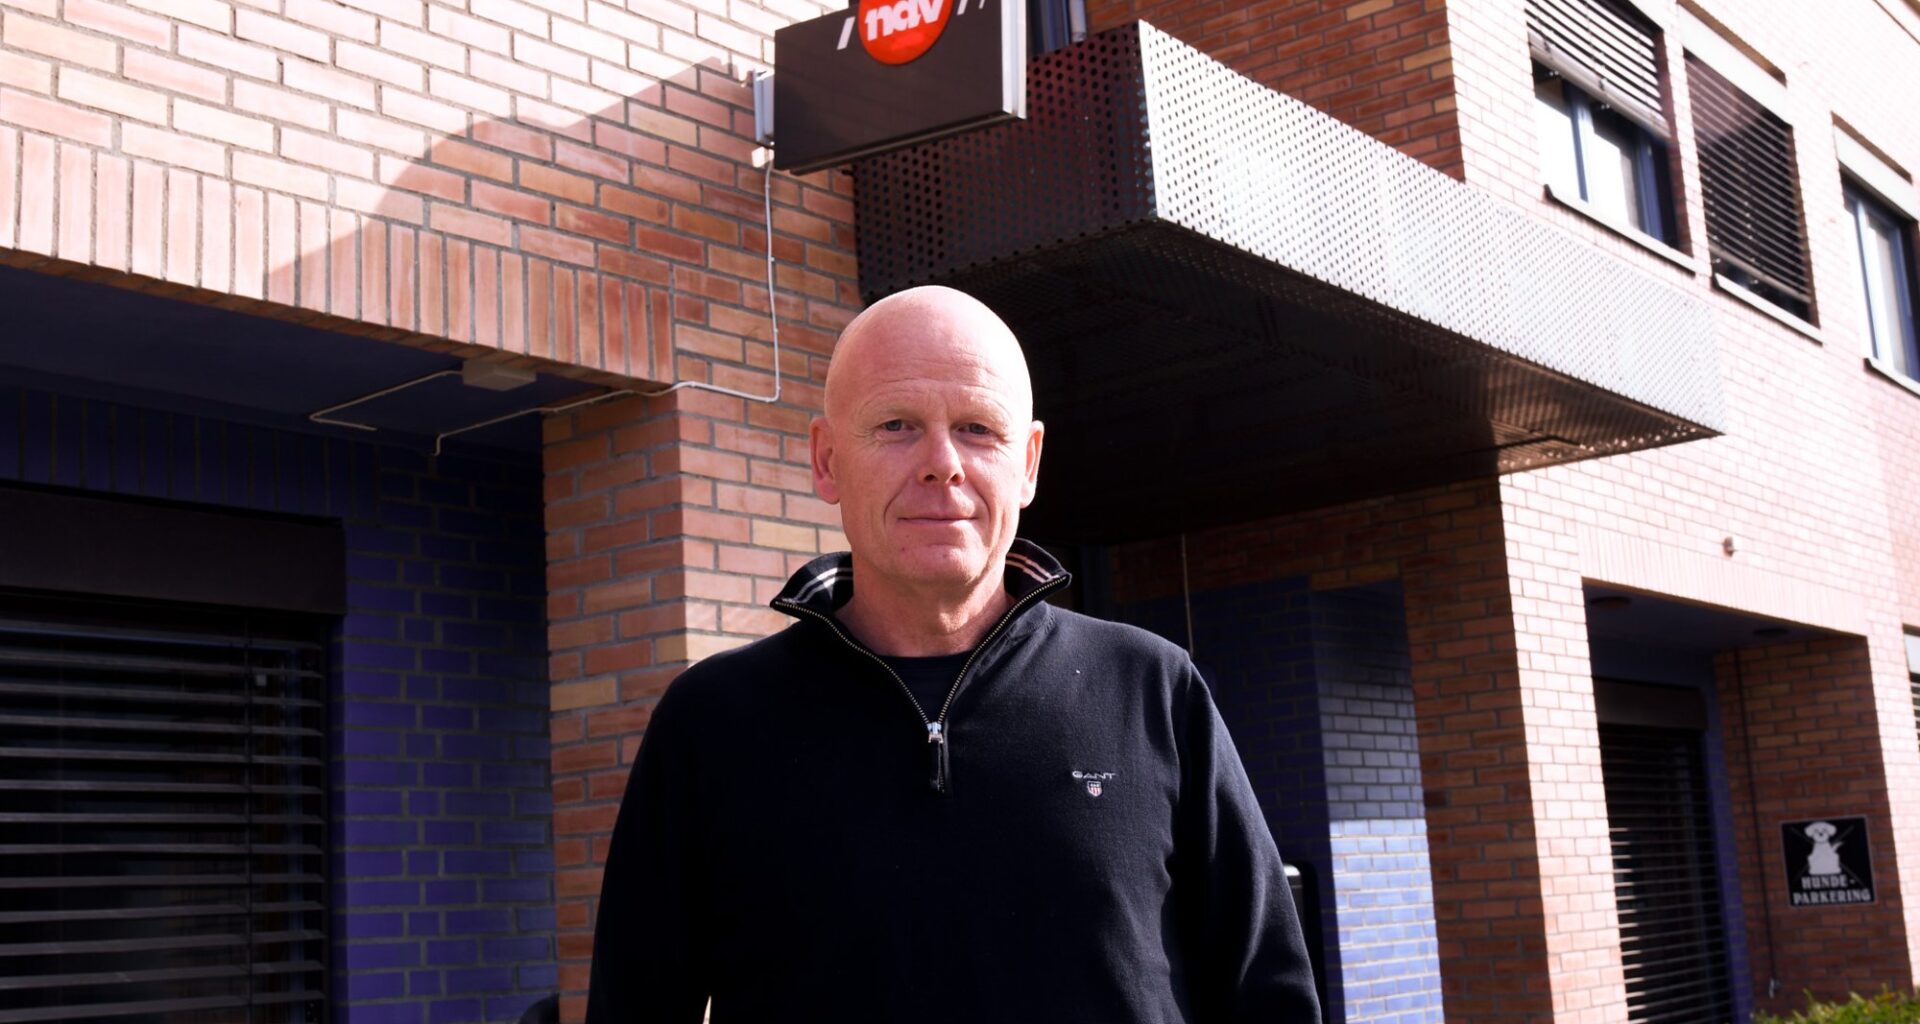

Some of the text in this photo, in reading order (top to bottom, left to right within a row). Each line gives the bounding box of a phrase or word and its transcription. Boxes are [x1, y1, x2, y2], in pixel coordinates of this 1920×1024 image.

[865, 0, 944, 41] nav
[1072, 770, 1117, 779] GANT
[1793, 888, 1871, 904] PARKERING
